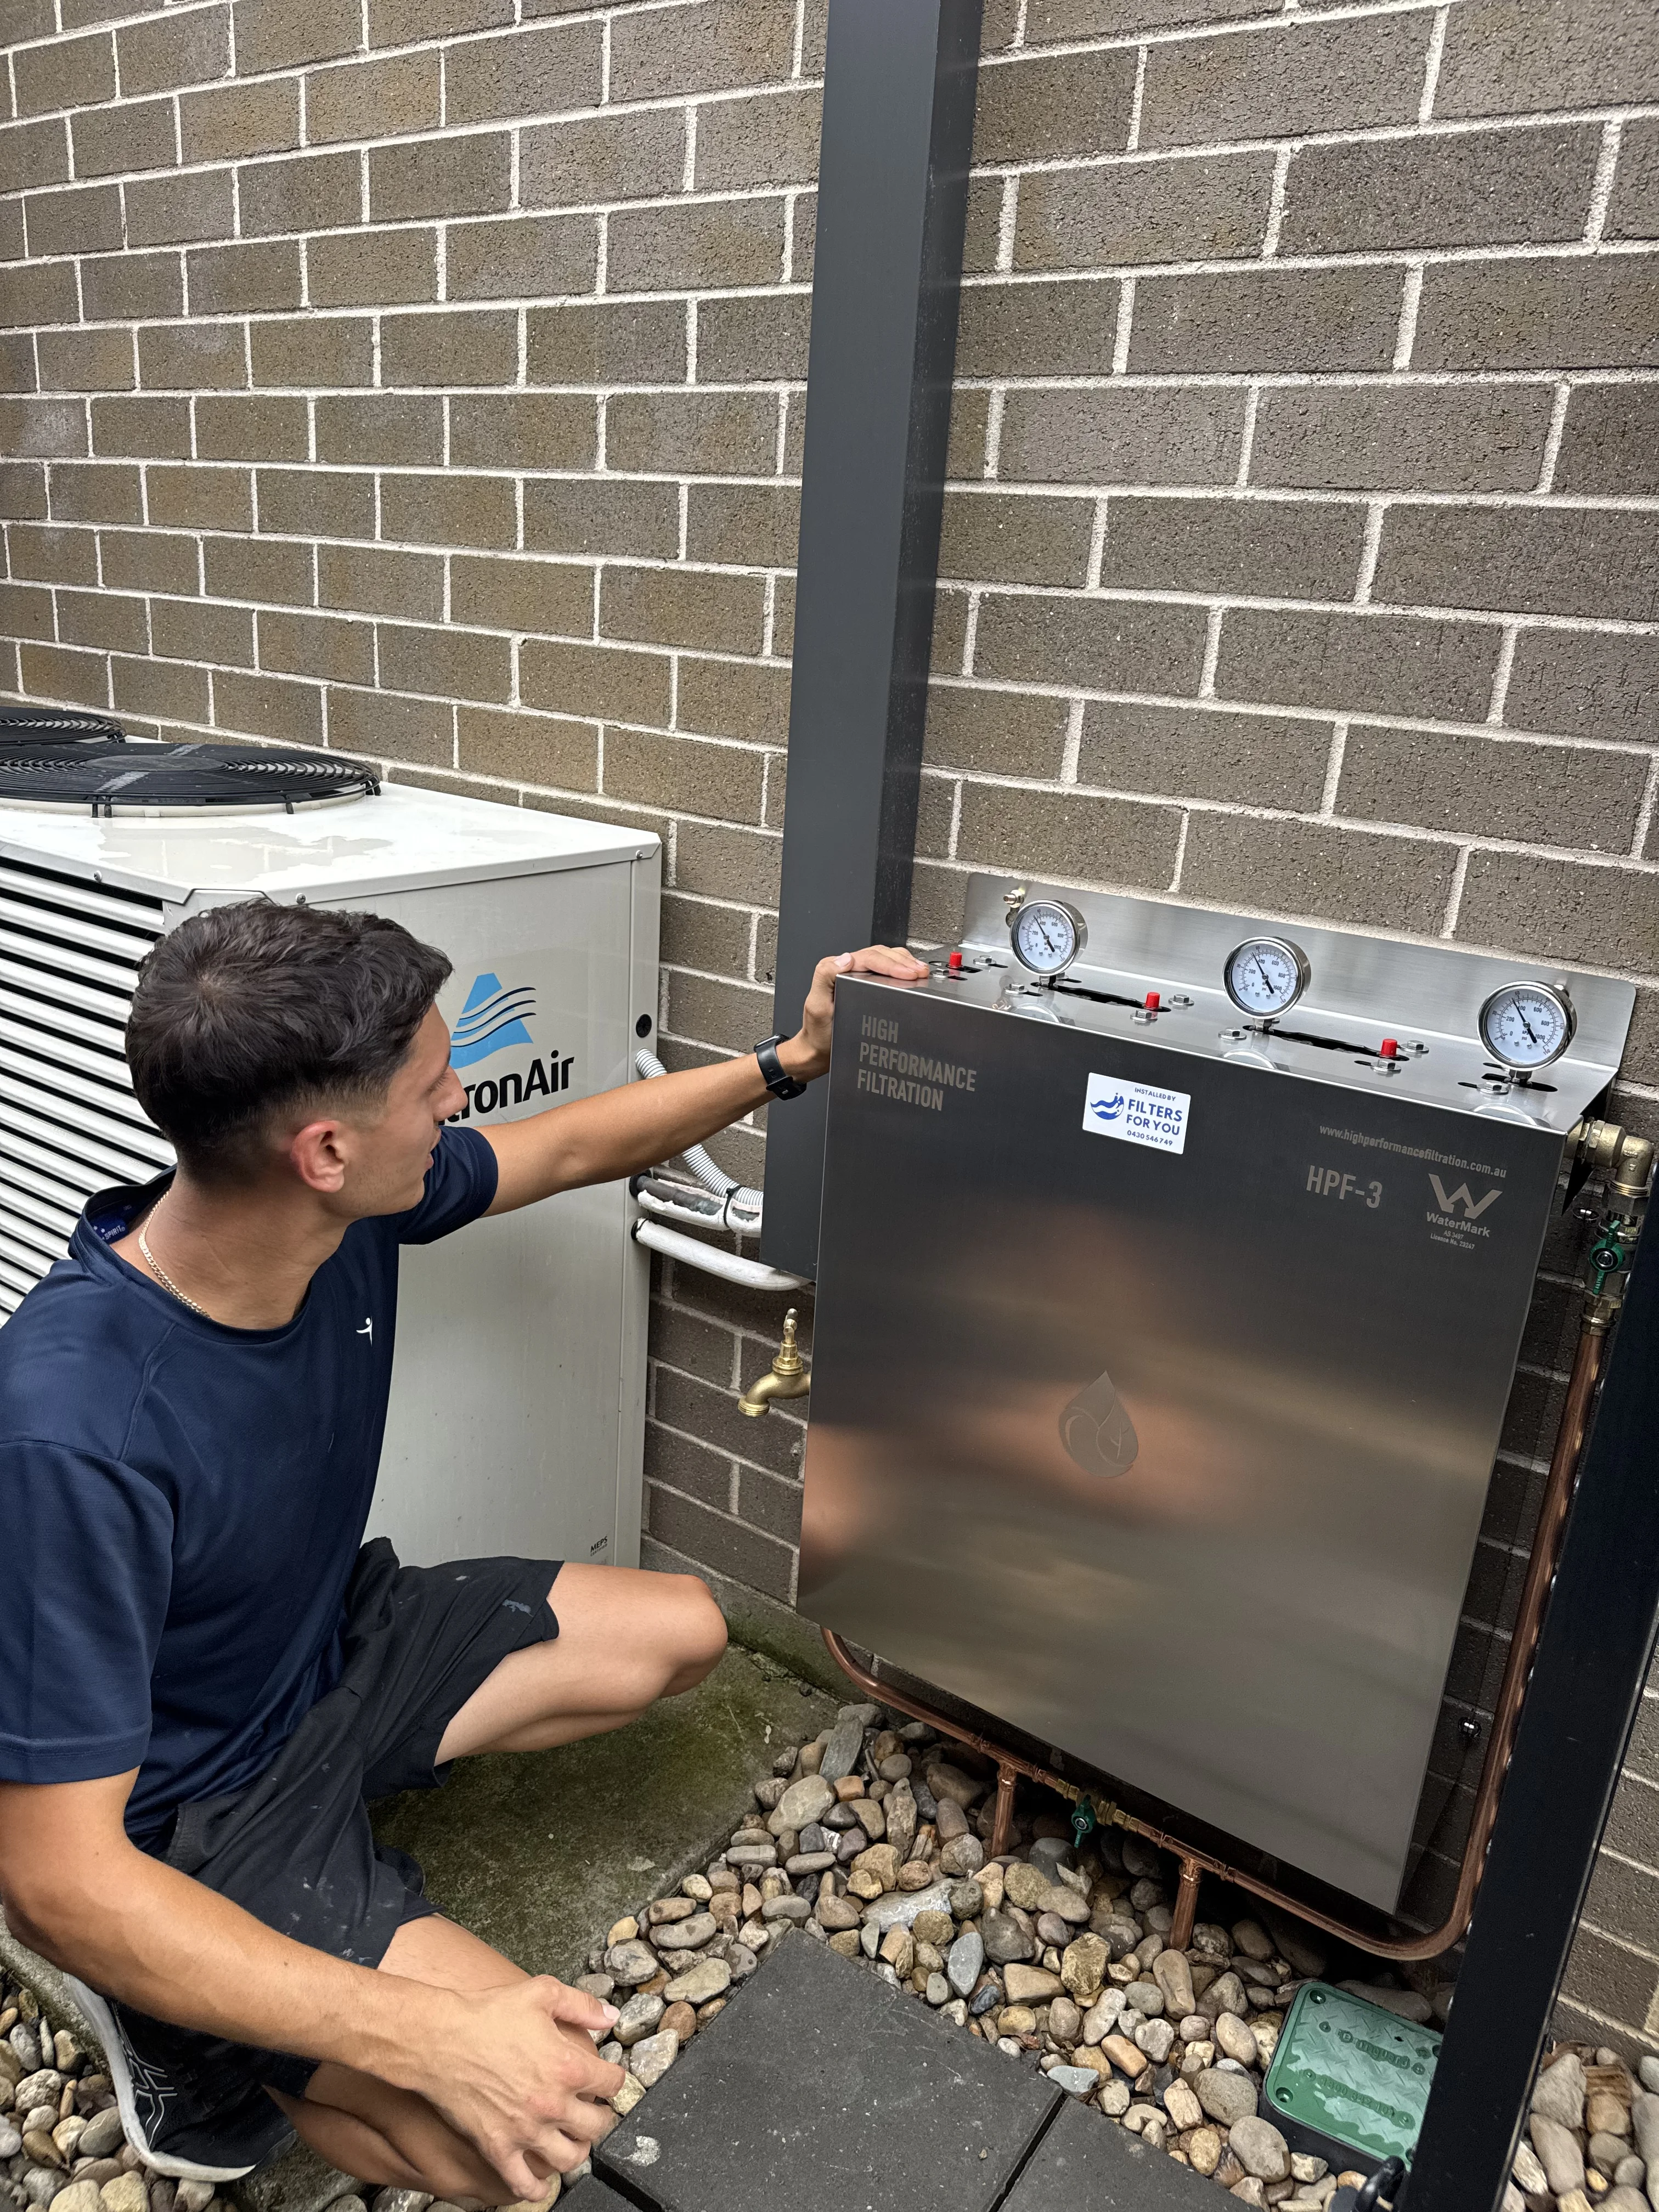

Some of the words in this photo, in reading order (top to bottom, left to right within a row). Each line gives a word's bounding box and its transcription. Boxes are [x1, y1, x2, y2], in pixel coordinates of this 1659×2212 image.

[861, 1015, 898, 1043] HIGH
[859, 1042, 977, 1092] PERFORMANCE
[857, 1068, 944, 1111] FILTRATION
[1135, 1087, 1166, 1100] INSTALLED
[1128, 1099, 1183, 1122] FILTERS
[1126, 1114, 1150, 1128] FOR
[1153, 1120, 1180, 1136] YOU
[1127, 1130, 1144, 1139] 0430
[1319, 1124, 1507, 1178] www.highperformancefiltration.com.au
[1306, 1165, 1383, 1209] HPF-3
[1426, 1211, 1491, 1238] WaterMark
[590, 1536, 608, 1553] MEPS
